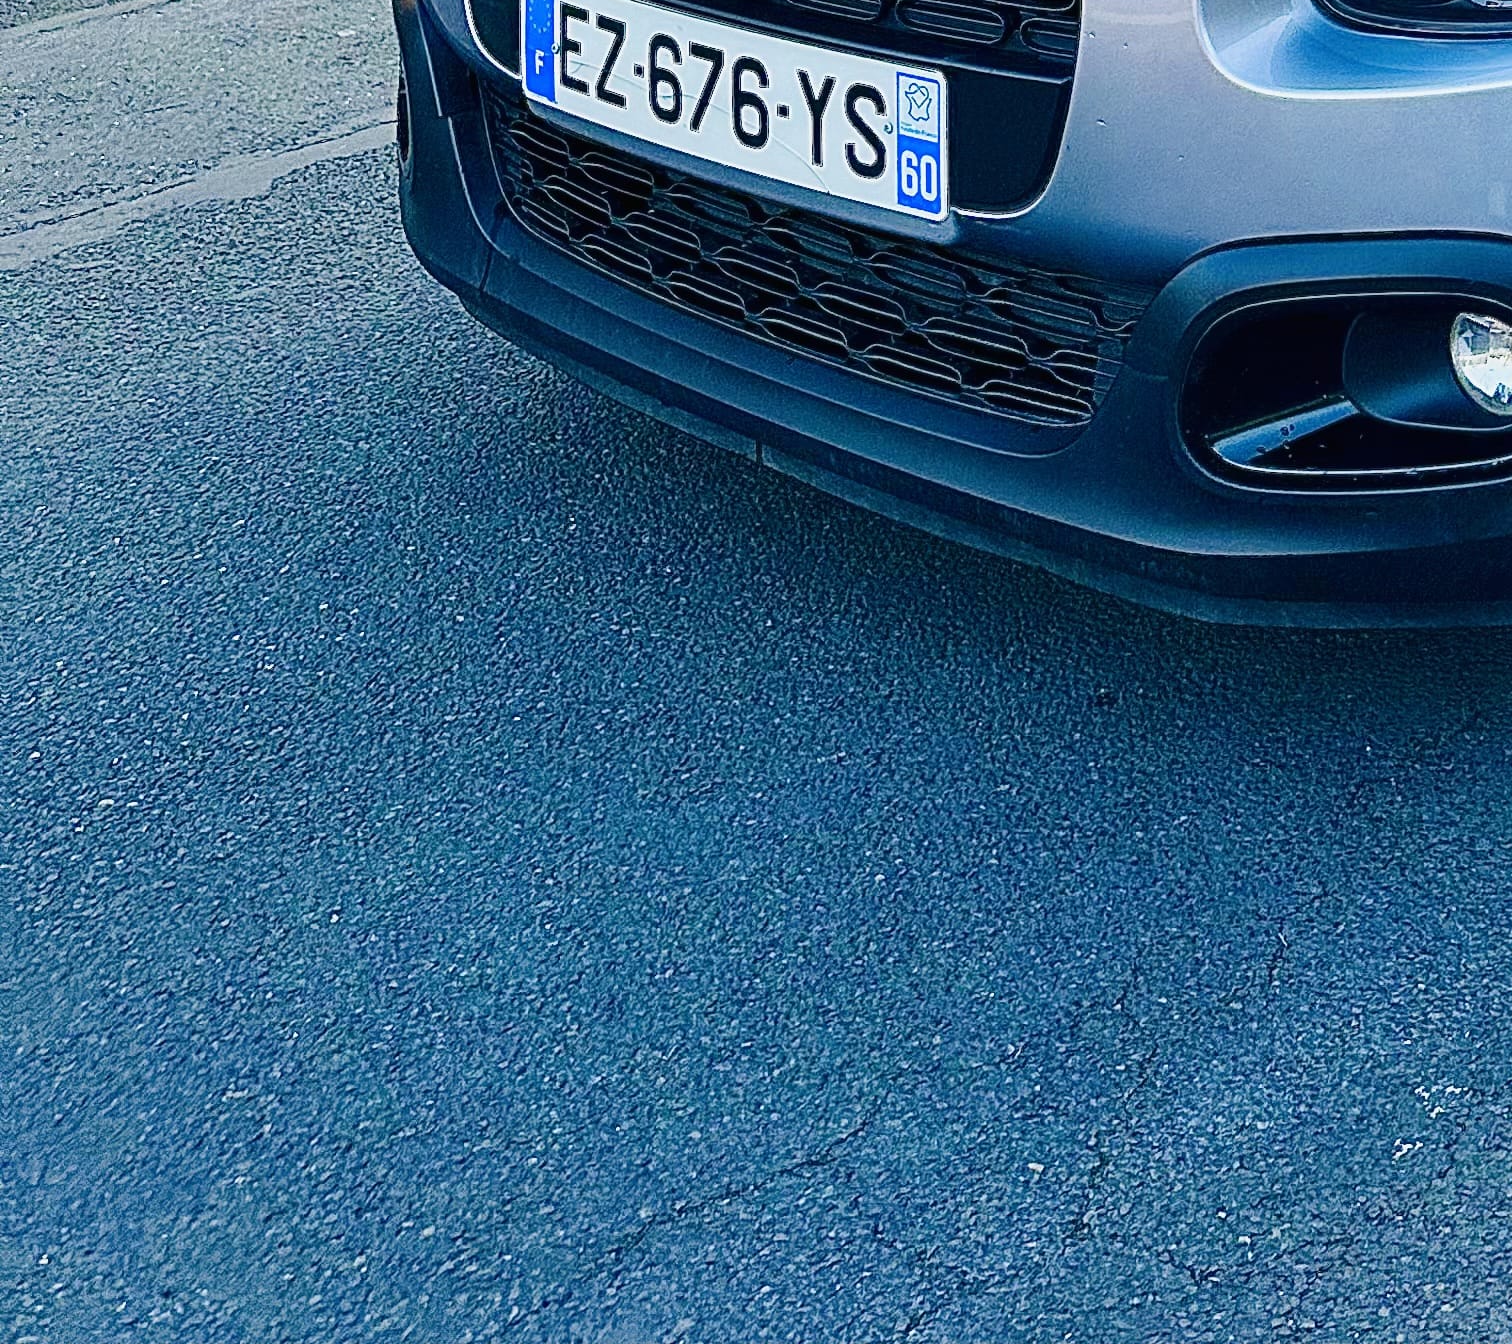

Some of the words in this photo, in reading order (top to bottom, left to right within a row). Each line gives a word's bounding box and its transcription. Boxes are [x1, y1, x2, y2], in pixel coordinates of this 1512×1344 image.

[534, 49, 545, 75] F
[559, 2, 888, 181] EZ-676-YS
[901, 149, 938, 202] 60
